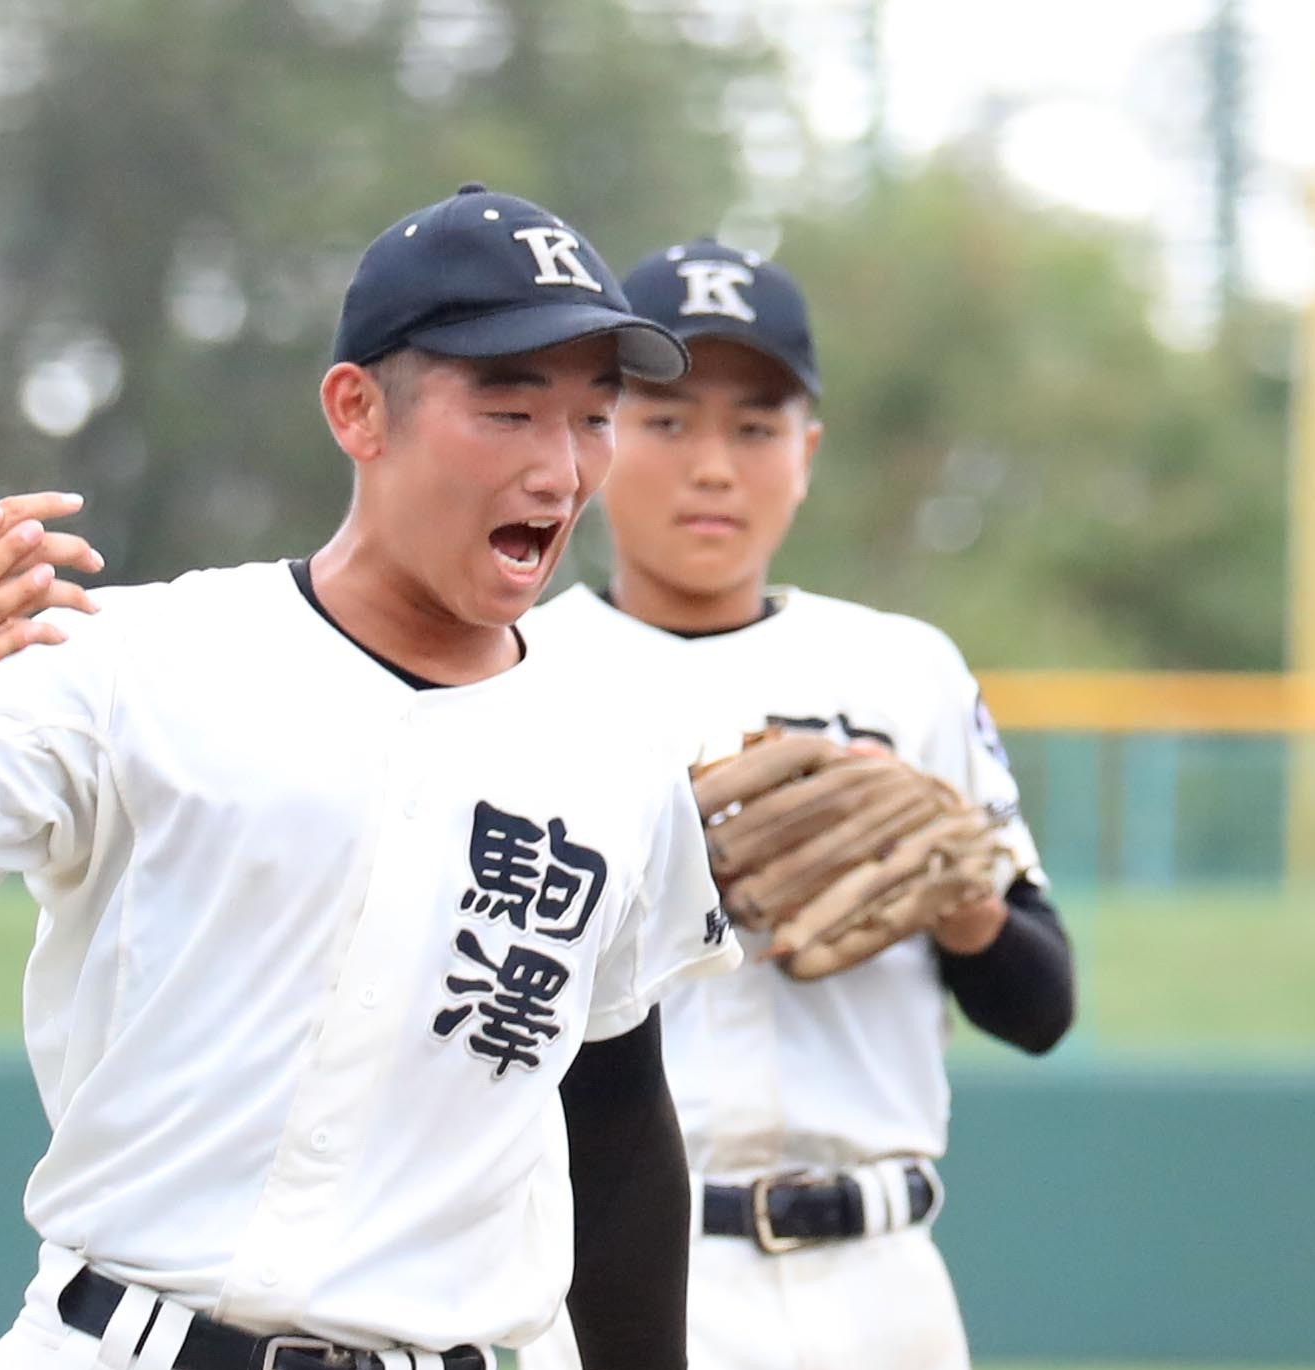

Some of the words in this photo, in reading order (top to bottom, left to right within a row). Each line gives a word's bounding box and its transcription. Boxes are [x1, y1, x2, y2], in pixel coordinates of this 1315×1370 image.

[513, 228, 602, 293] K
[677, 260, 757, 323] K
[433, 799, 608, 1076] 駒澤
